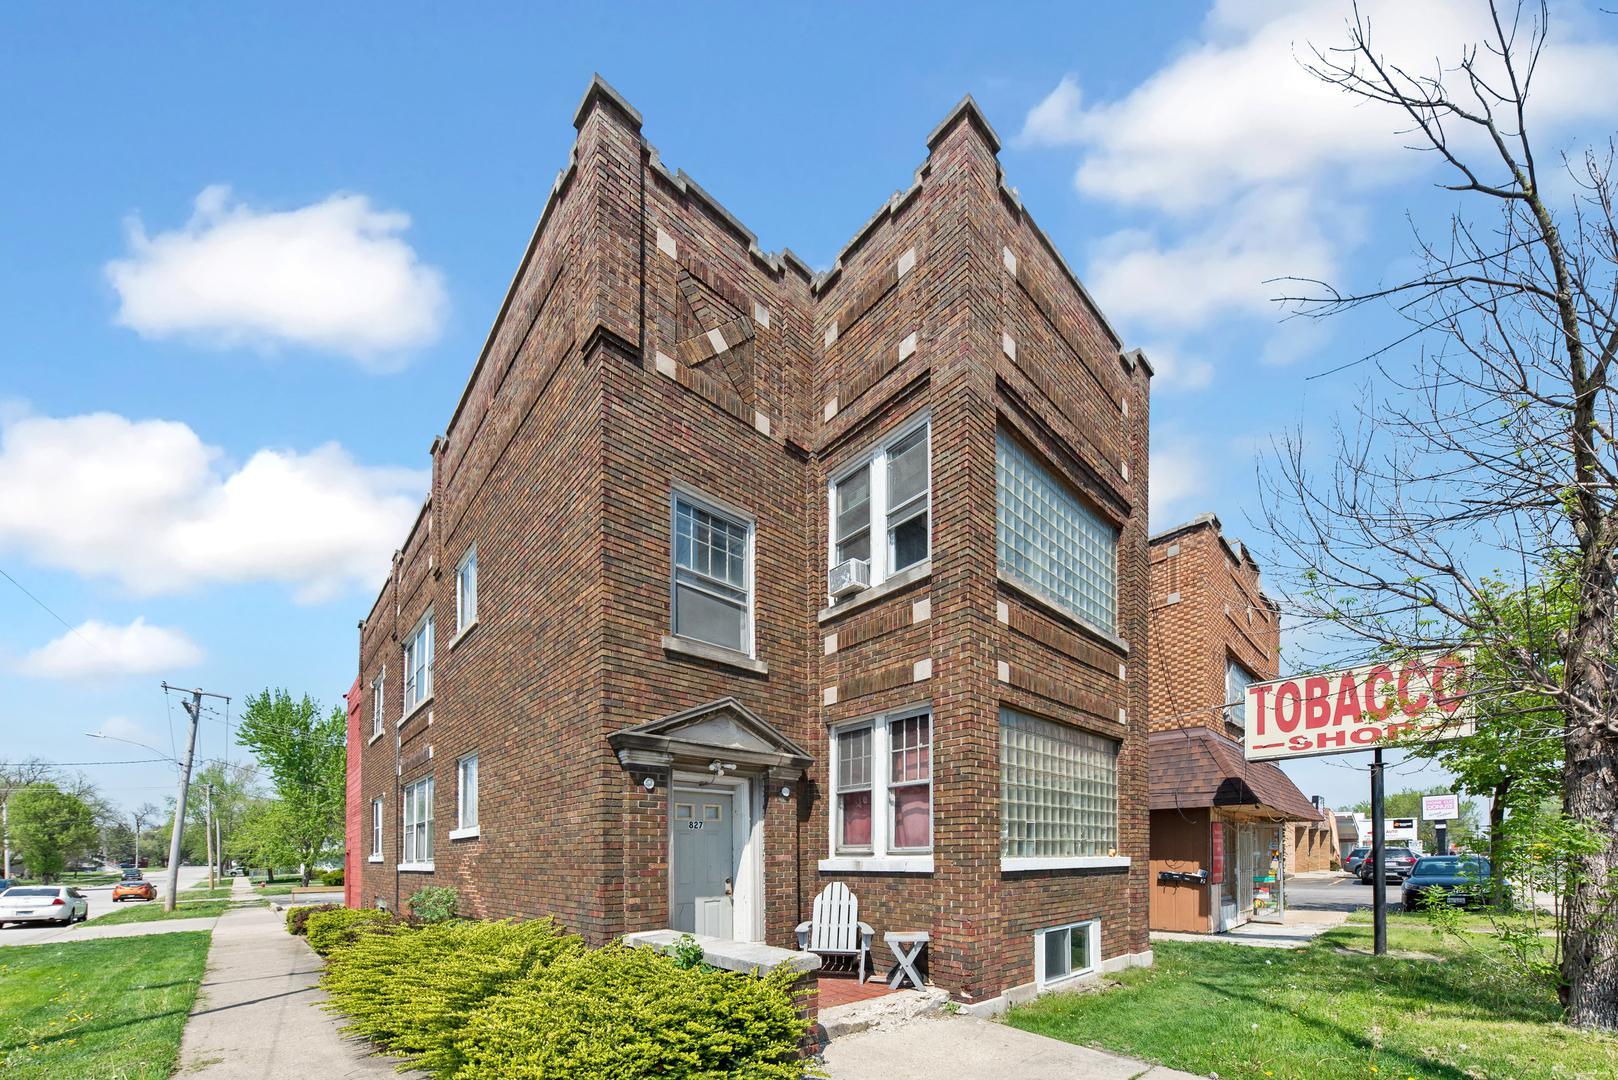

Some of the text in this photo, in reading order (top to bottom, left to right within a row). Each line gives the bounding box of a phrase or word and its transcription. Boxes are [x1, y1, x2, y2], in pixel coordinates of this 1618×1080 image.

[1249, 655, 1466, 736] TOBACCO
[1288, 722, 1407, 751] SHOP
[688, 821, 703, 829] 827
